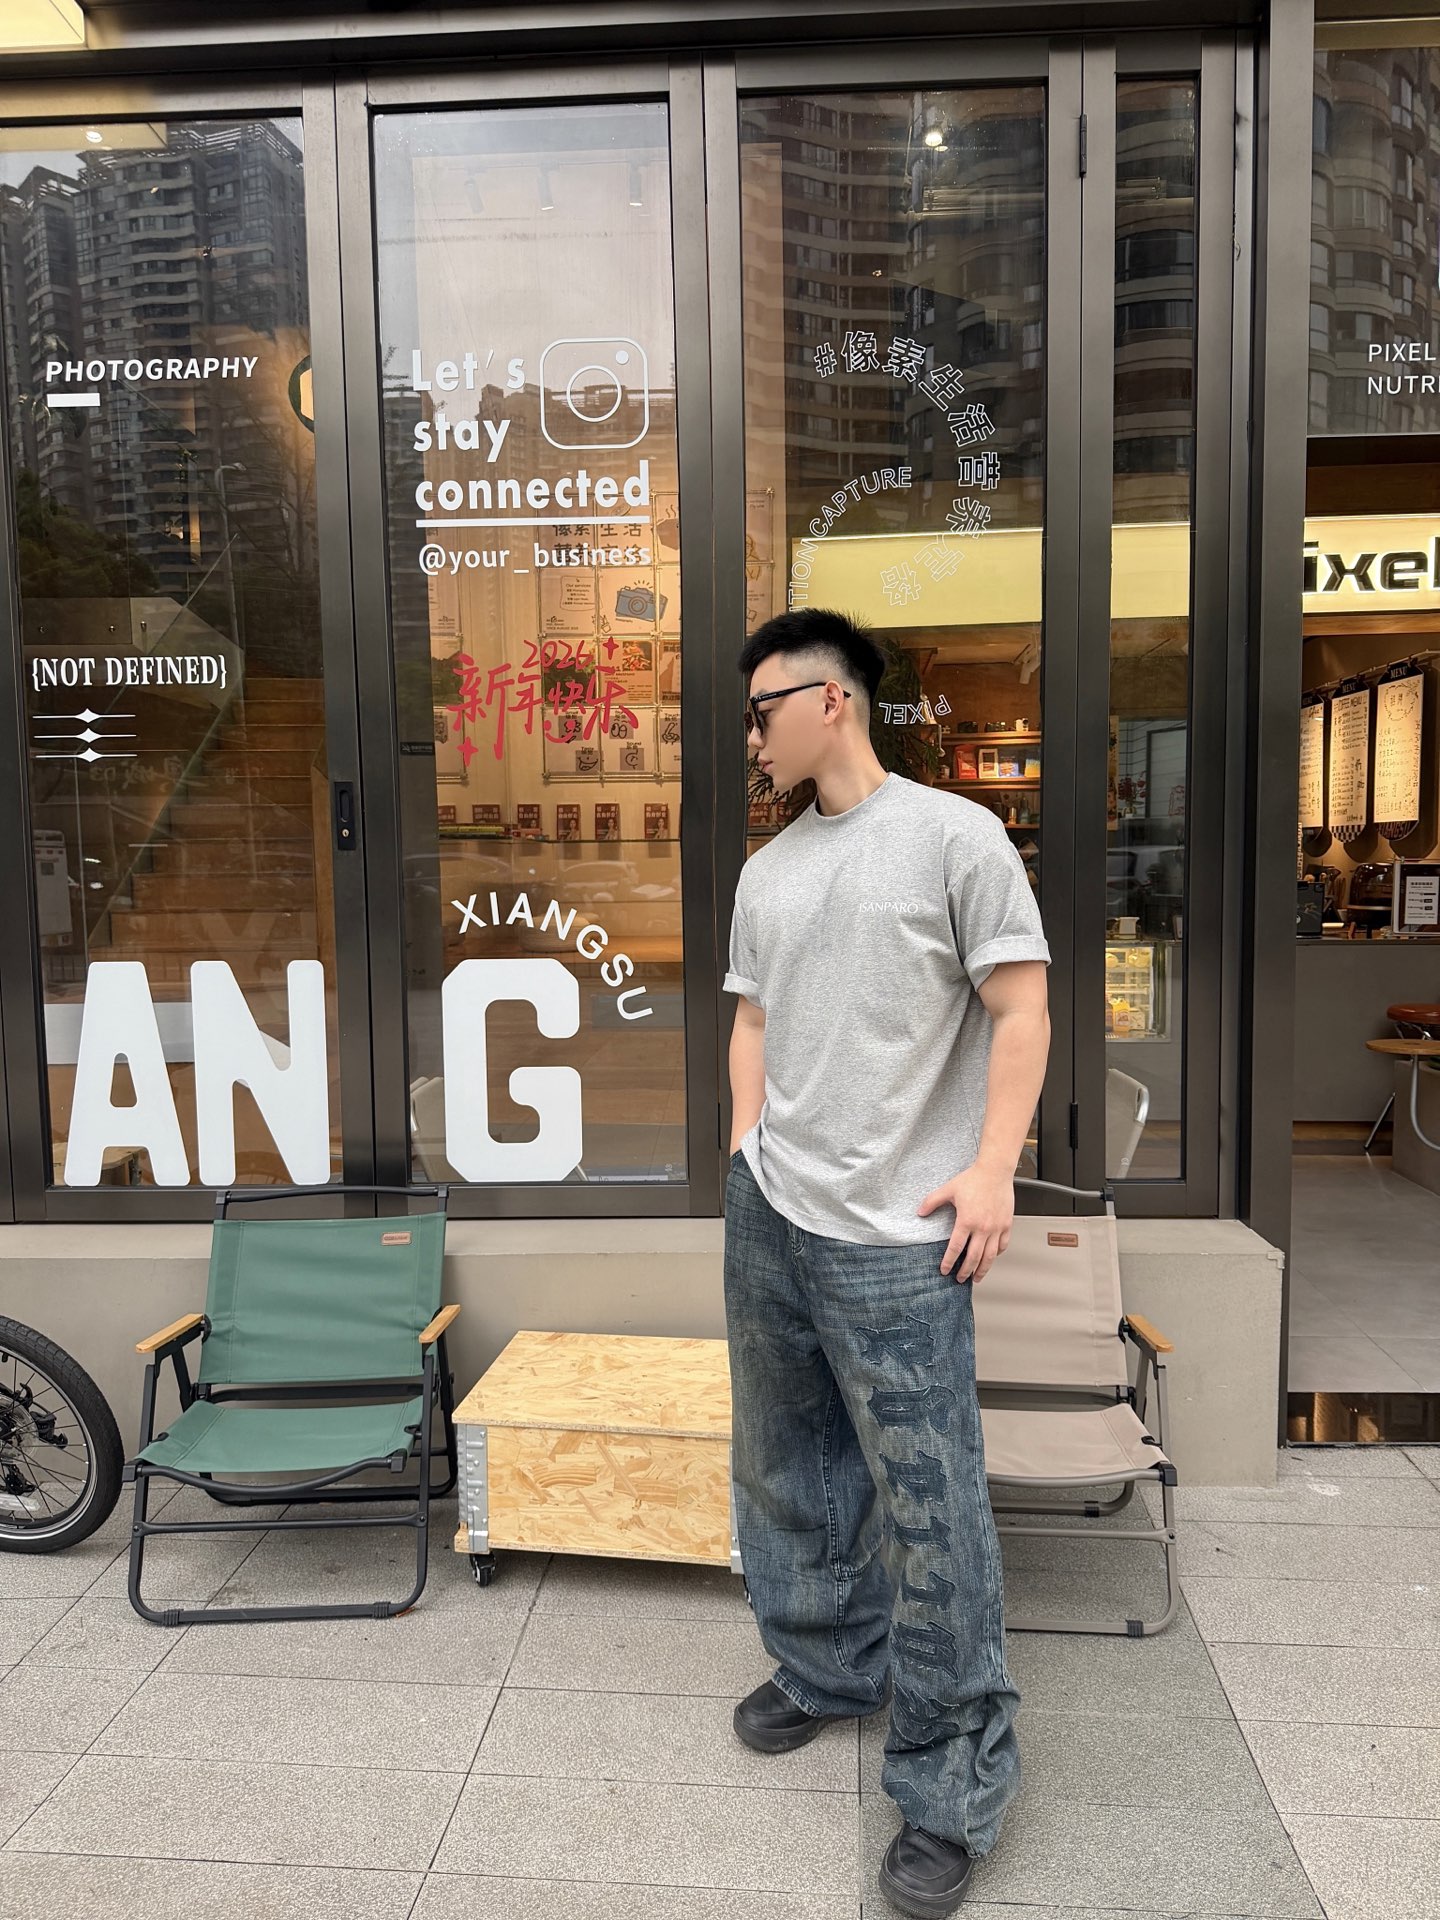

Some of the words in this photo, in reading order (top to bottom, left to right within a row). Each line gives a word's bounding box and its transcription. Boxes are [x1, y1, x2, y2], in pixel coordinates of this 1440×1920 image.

[46, 356, 259, 382] PHOTOGRAPHY
[1368, 342, 1437, 362] PIXEL
[413, 414, 511, 463] stay
[415, 459, 650, 511] connected
[810, 466, 912, 537] CAPTURE
[32, 657, 96, 692] {NOT
[106, 655, 228, 689] DEFINED}
[523, 640, 594, 669] 2026
[445, 653, 640, 760] 新年快乐
[878, 694, 952, 724] PIXEL
[451, 891, 653, 1020] XIANGSU
